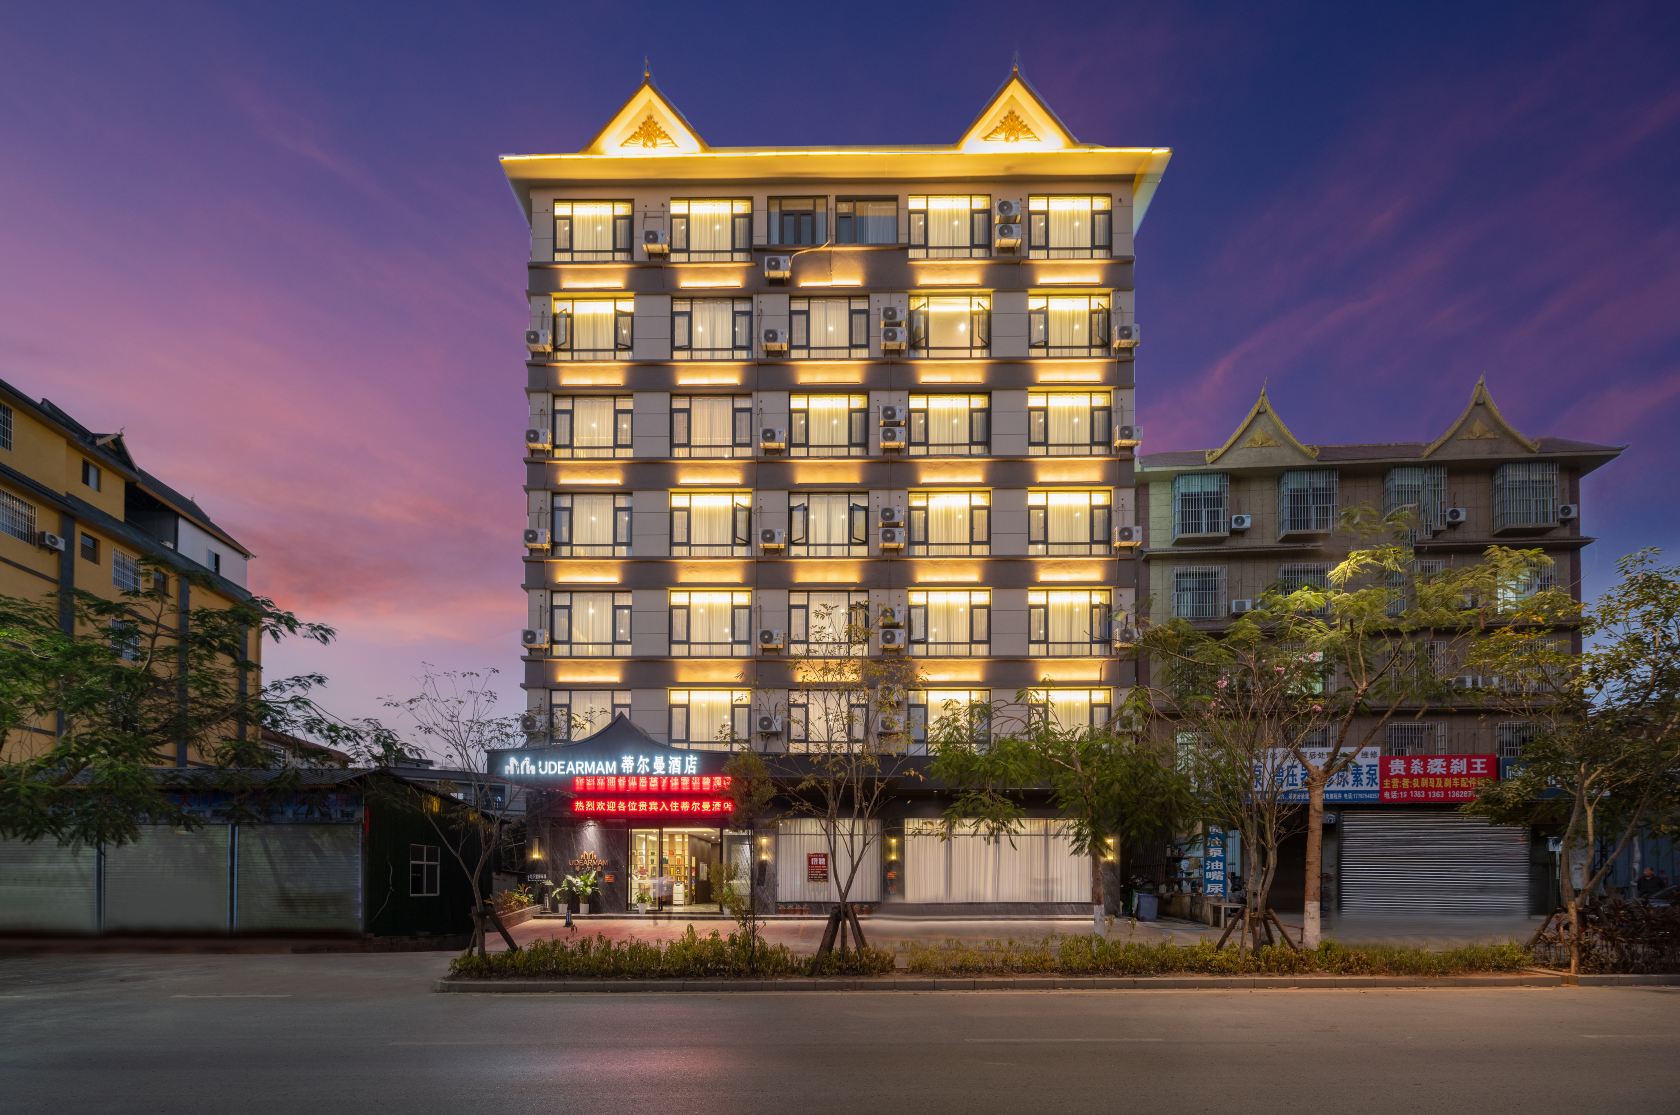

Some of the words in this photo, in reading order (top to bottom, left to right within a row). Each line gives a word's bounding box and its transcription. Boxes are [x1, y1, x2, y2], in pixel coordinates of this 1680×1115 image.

[539, 760, 617, 775] UDEARMAM
[621, 755, 698, 775] 蒂尔曼酒店
